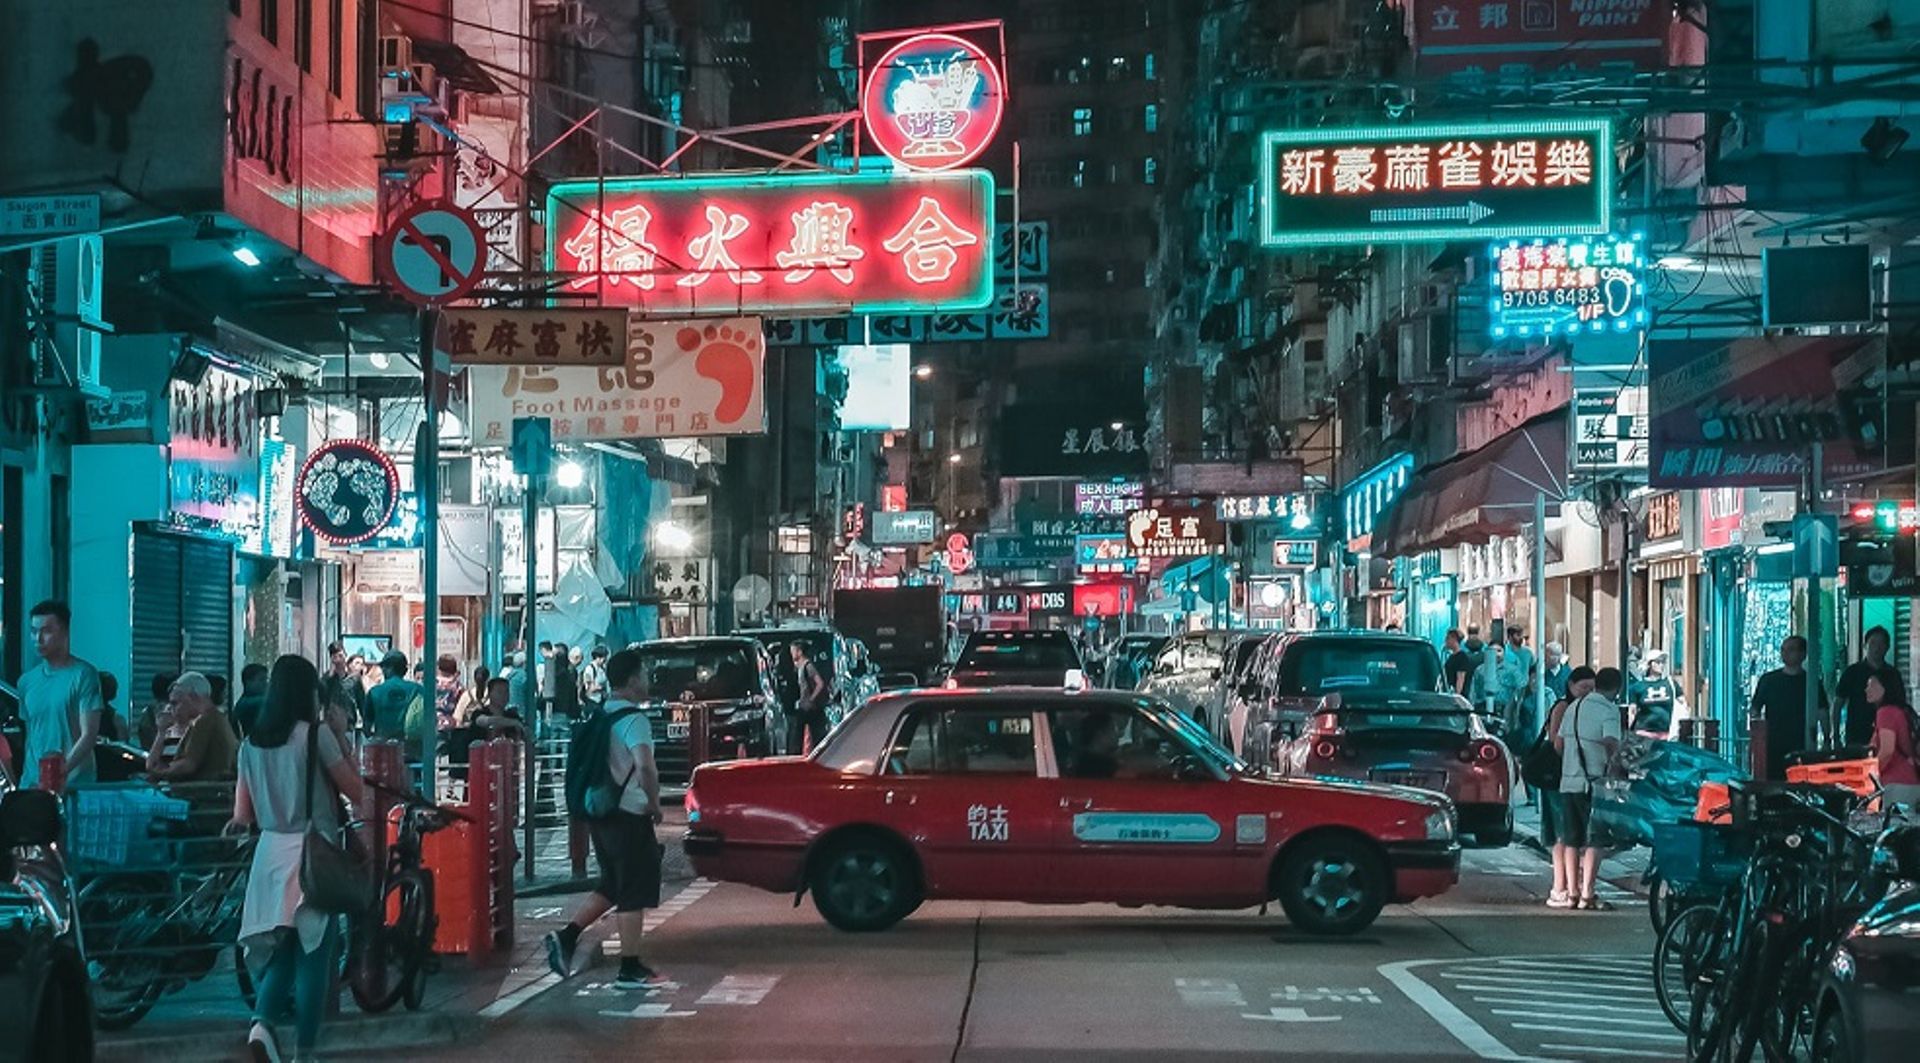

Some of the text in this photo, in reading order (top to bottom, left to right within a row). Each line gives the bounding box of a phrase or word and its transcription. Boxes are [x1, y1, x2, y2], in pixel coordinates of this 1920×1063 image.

[1432, 6, 1508, 30] 立邦
[1578, 11, 1642, 27] PAINT
[7, 199, 93, 213] Saigon Street
[1554, 287, 1600, 304] 6483
[1576, 303, 1605, 321] 1/F
[512, 396, 681, 414] Foot Massage
[486, 412, 710, 441] 足按摩專門店
[1079, 483, 1102, 495] SEX
[1041, 592, 1066, 609] DBS
[968, 803, 1009, 822] 的士
[968, 821, 1009, 841] TAXI
